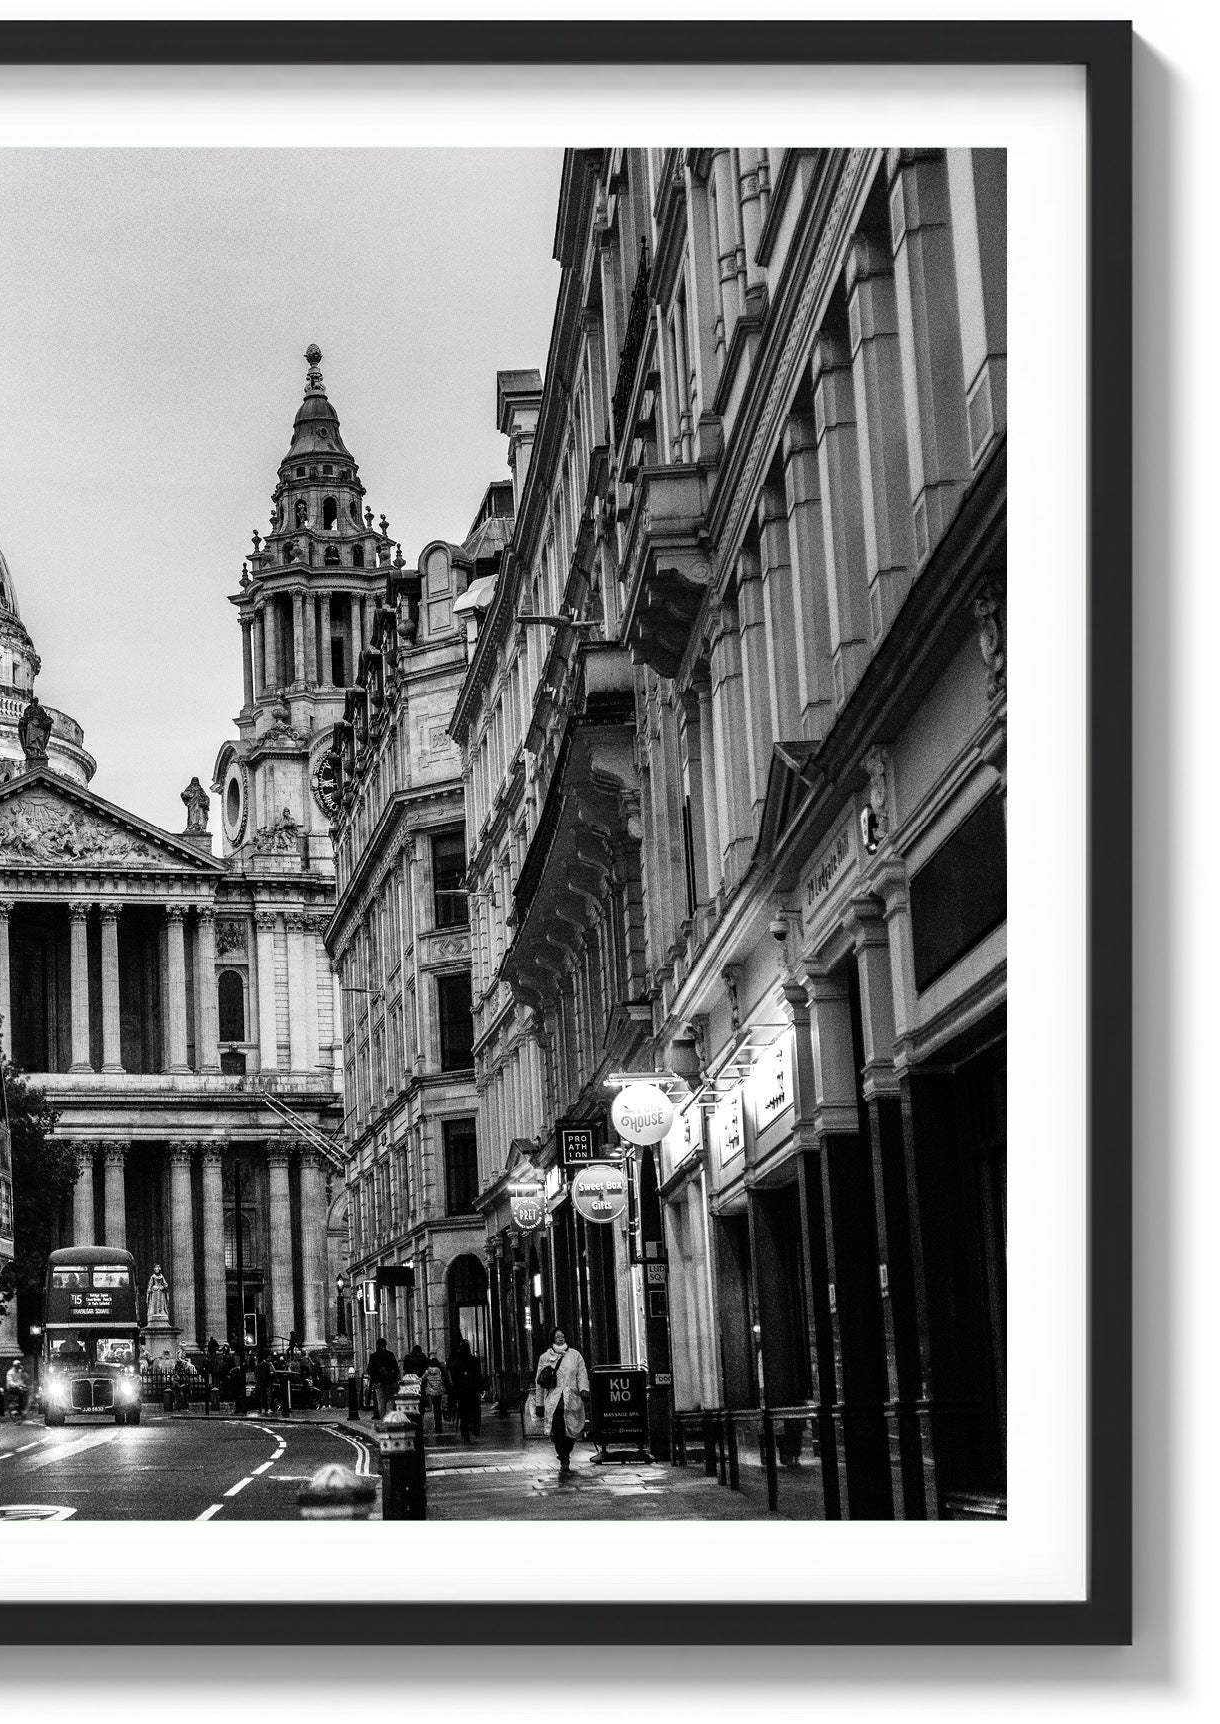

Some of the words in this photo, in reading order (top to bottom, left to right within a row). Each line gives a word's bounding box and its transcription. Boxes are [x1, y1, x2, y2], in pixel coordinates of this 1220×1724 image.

[621, 1112, 664, 1133] HOUSE
[568, 1143, 588, 1151] ATH
[578, 1182, 604, 1191] Sweet
[606, 1181, 622, 1190] Box
[591, 1200, 613, 1210] Gifts
[520, 1209, 536, 1220] PRET
[610, 1378, 630, 1390] KU
[610, 1390, 632, 1402] MO
